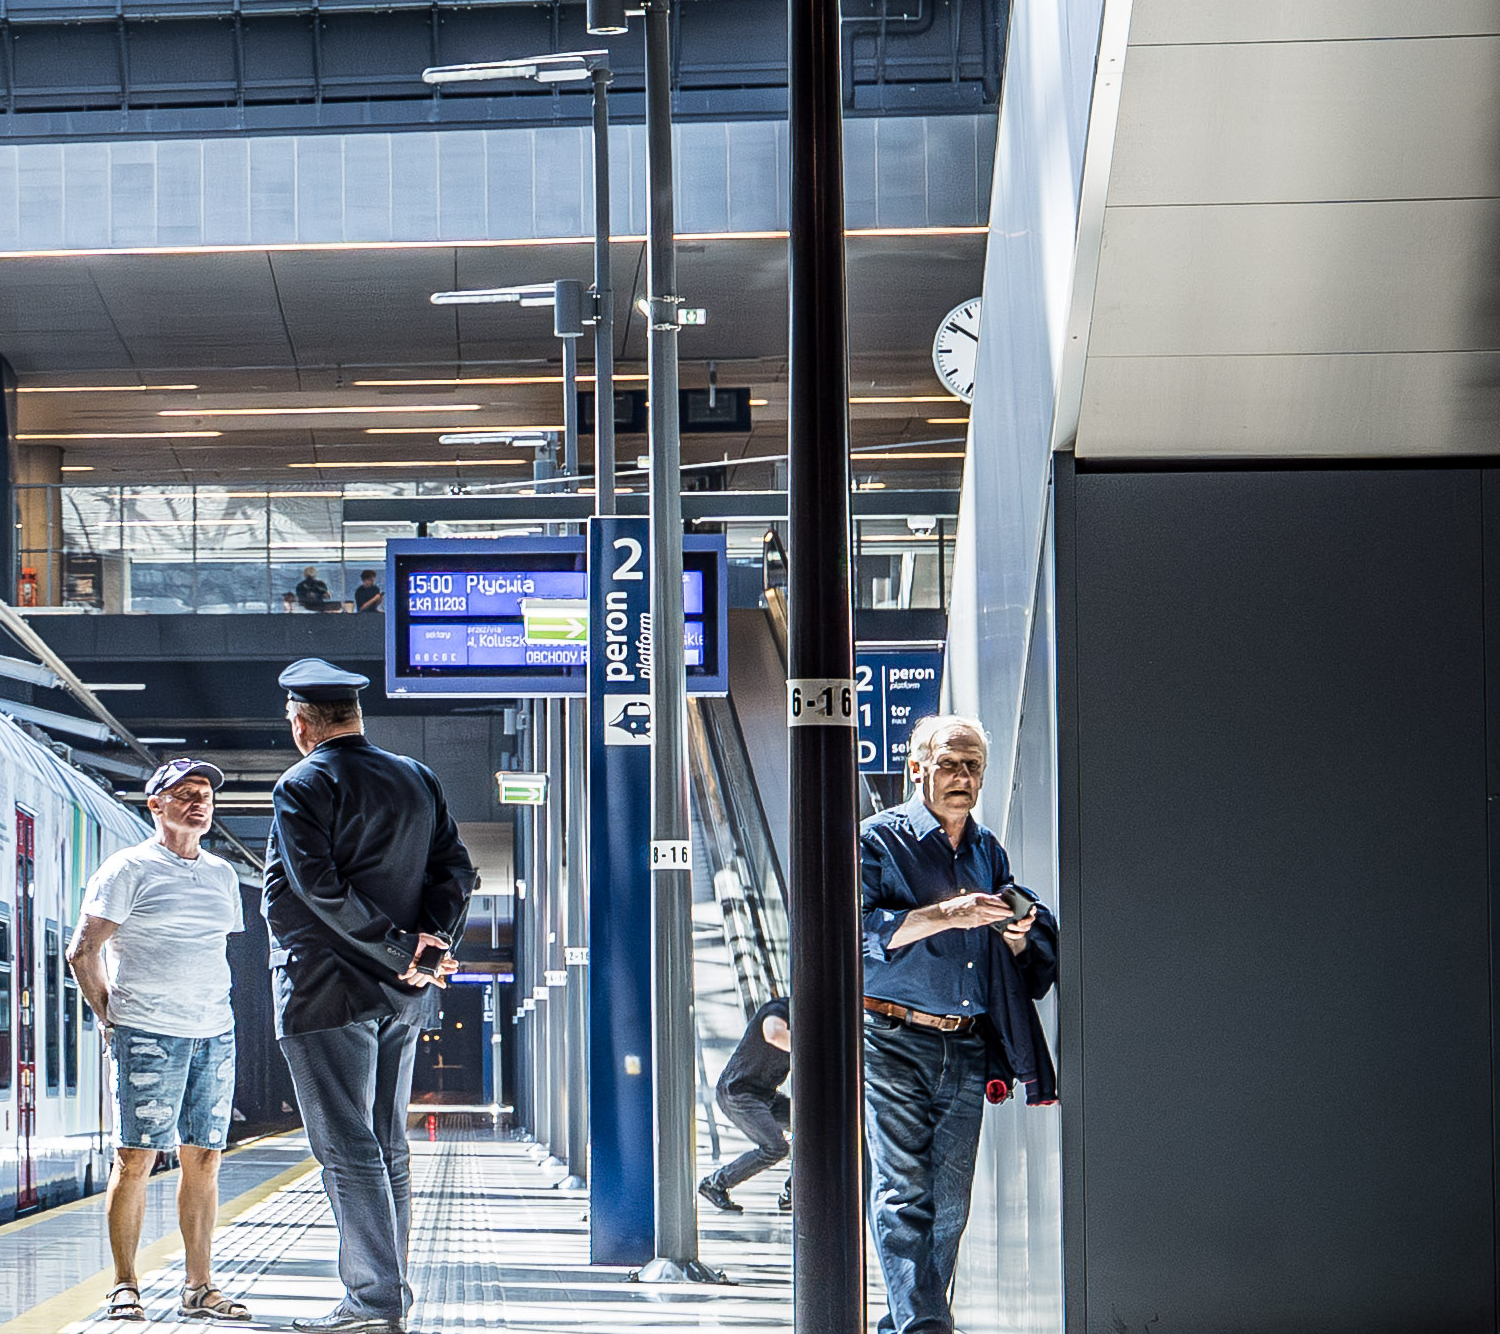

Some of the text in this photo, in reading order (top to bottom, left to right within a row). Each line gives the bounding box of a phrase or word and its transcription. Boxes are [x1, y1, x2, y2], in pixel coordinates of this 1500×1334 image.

[409, 574, 535, 596] 15:00 Płyćwia
[434, 596, 466, 612] 11203
[605, 537, 644, 682] peron 2
[526, 651, 577, 664] OBCHODY
[634, 612, 651, 680] platform
[856, 665, 935, 692] 2 peron
[792, 687, 852, 717] 6-16
[859, 703, 911, 727] 1 tor
[858, 740, 877, 764] D
[653, 846, 688, 864] 8-16
